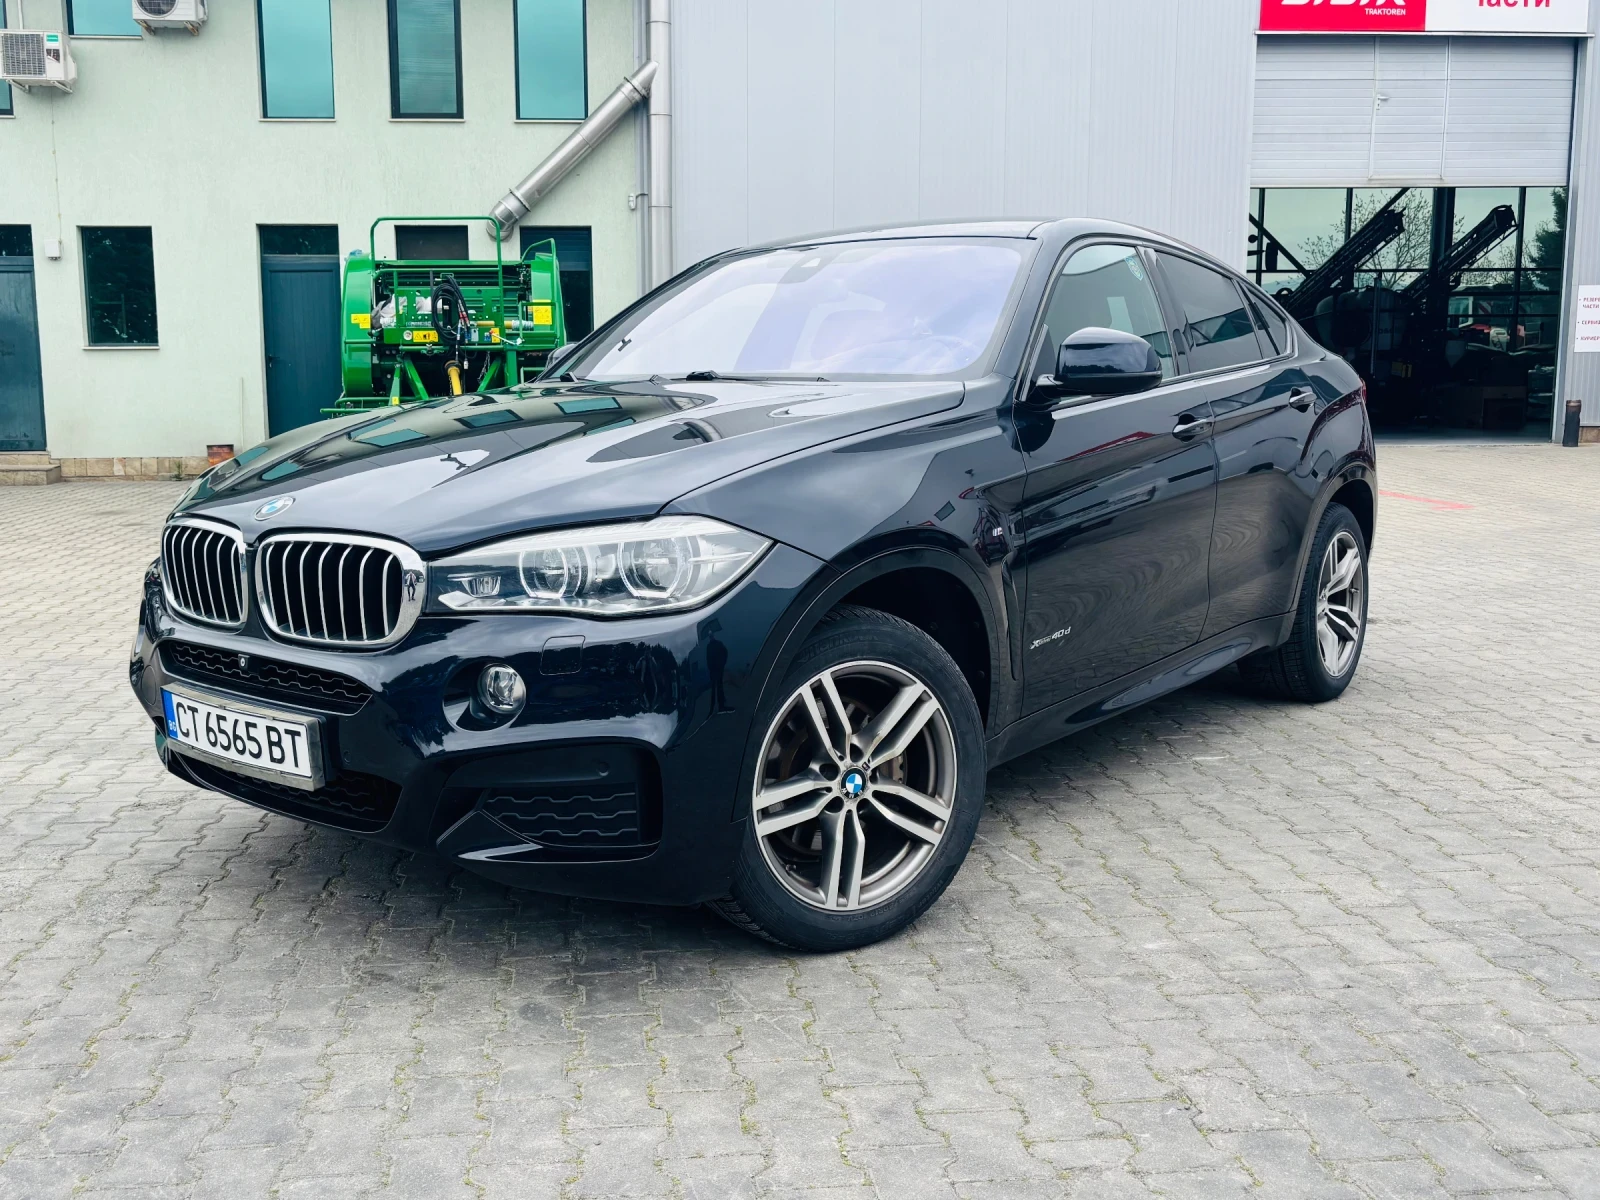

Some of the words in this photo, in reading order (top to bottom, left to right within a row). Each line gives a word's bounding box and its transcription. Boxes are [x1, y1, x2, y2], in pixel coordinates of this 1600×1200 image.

[1364, 7, 1406, 16] TRAKTOREN
[168, 719, 177, 732] BG
[175, 701, 199, 742] CT
[205, 711, 262, 760] 6565
[265, 724, 301, 769] BT
